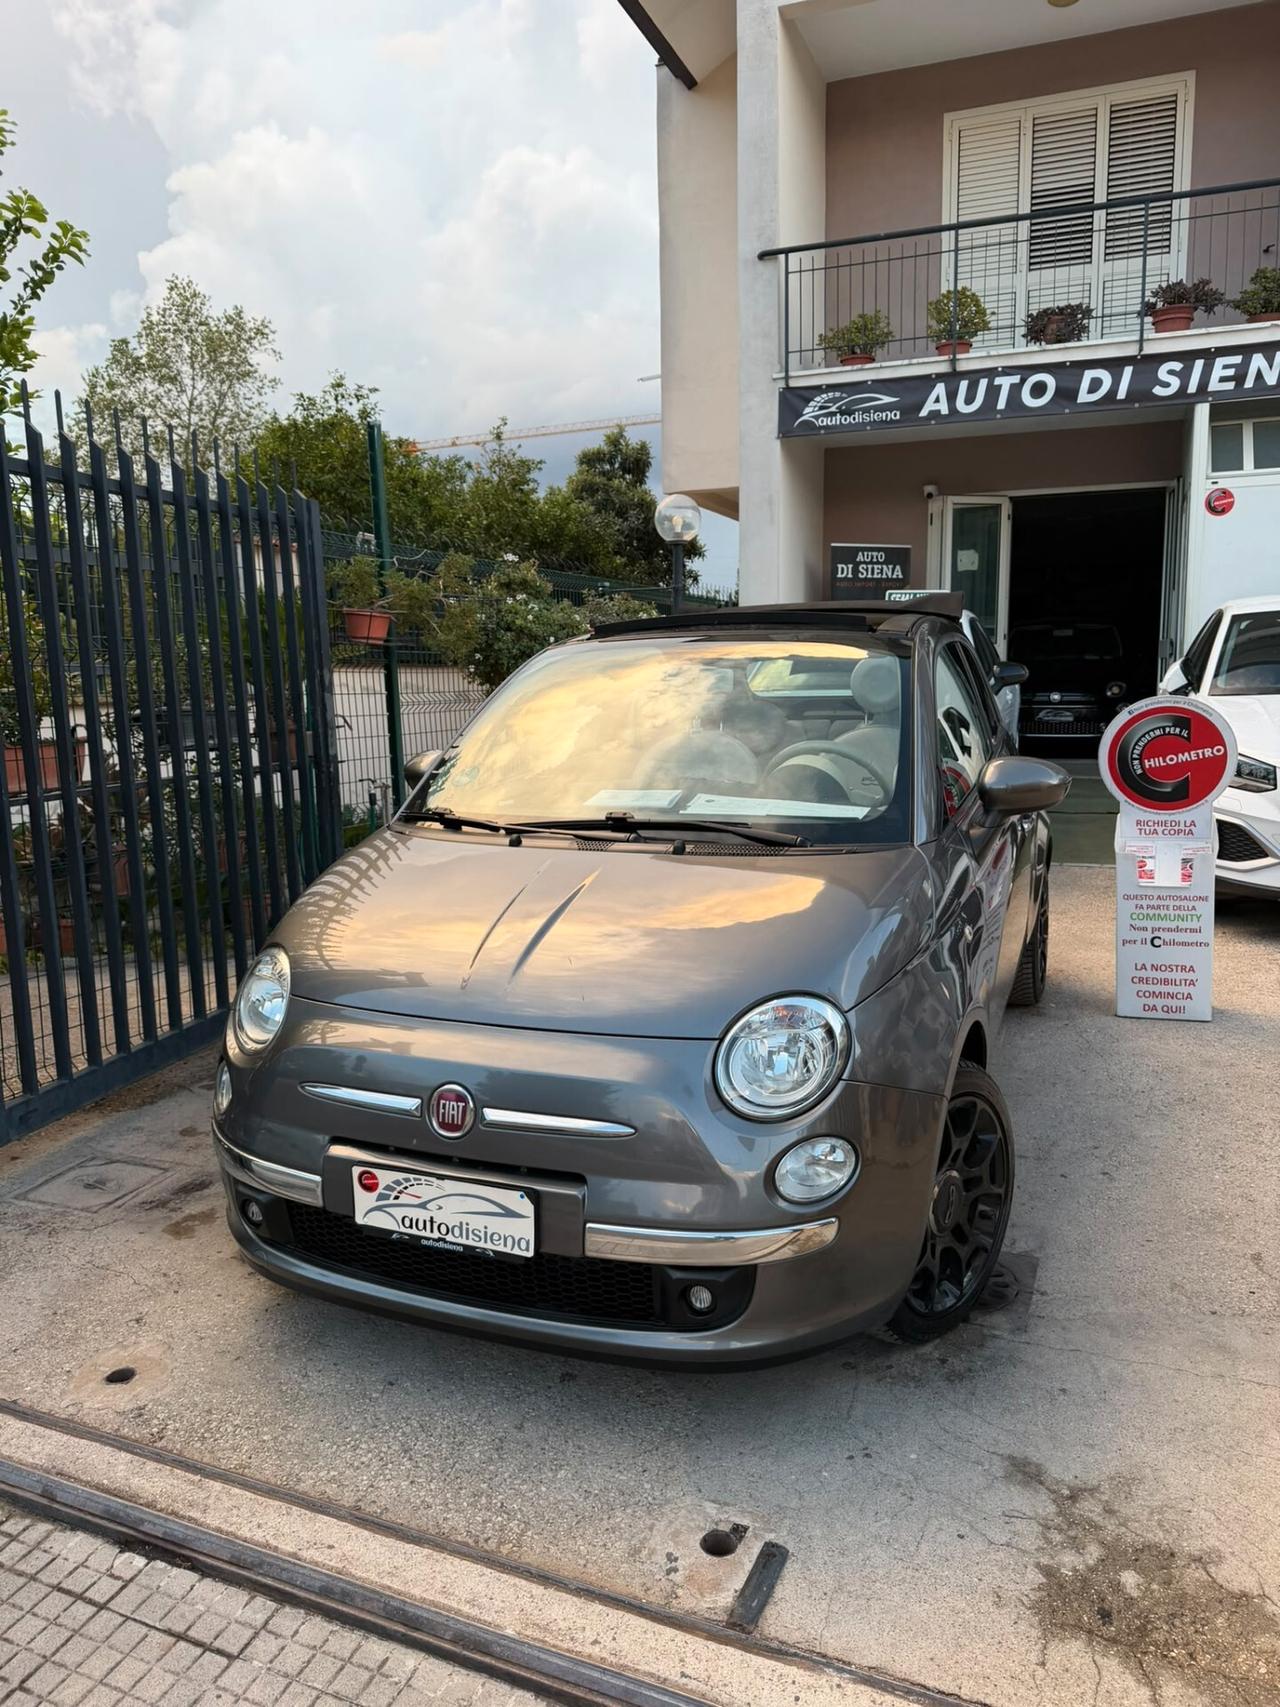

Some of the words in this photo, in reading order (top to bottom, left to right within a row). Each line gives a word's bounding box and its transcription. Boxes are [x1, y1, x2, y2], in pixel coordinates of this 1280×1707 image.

[918, 372, 1057, 418] AUTO
[1076, 365, 1134, 404] DI
[1152, 351, 1280, 397] SIEN
[818, 407, 901, 427] autodisiena
[856, 551, 886, 562] AUTO
[836, 564, 853, 578] DI
[858, 564, 904, 579] SIENA
[1165, 727, 1180, 736] PER
[1181, 730, 1189, 738] IL
[1133, 728, 1164, 759] PRENDERMI
[1131, 757, 1142, 775] NON
[1136, 819, 1181, 828] RICHIEDI
[1183, 820, 1197, 828] LA
[1137, 828, 1160, 836] TUA
[1161, 828, 1195, 837] COPIA
[1122, 894, 1154, 902] QUESTO
[1156, 895, 1209, 903] AUTOSALONE
[1134, 903, 1145, 911] FA
[1172, 904, 1197, 912] DELLA
[1129, 912, 1203, 923] COMMUNITY
[1129, 924, 1149, 933] Non
[1151, 925, 1202, 935] prendermi
[1122, 938, 1137, 947] per
[1139, 937, 1148, 946] il
[1150, 935, 1210, 949] Chilometro
[1134, 962, 1147, 971] LA
[1150, 963, 1196, 974] NOSTRA
[1136, 989, 1193, 1001] COMINCIA
[1142, 1003, 1159, 1013] DA
[1161, 1005, 1186, 1014] QUI!
[439, 1099, 465, 1126] FIAT
[401, 1214, 530, 1252] autodisiena
[420, 1237, 464, 1252] autodisiena
